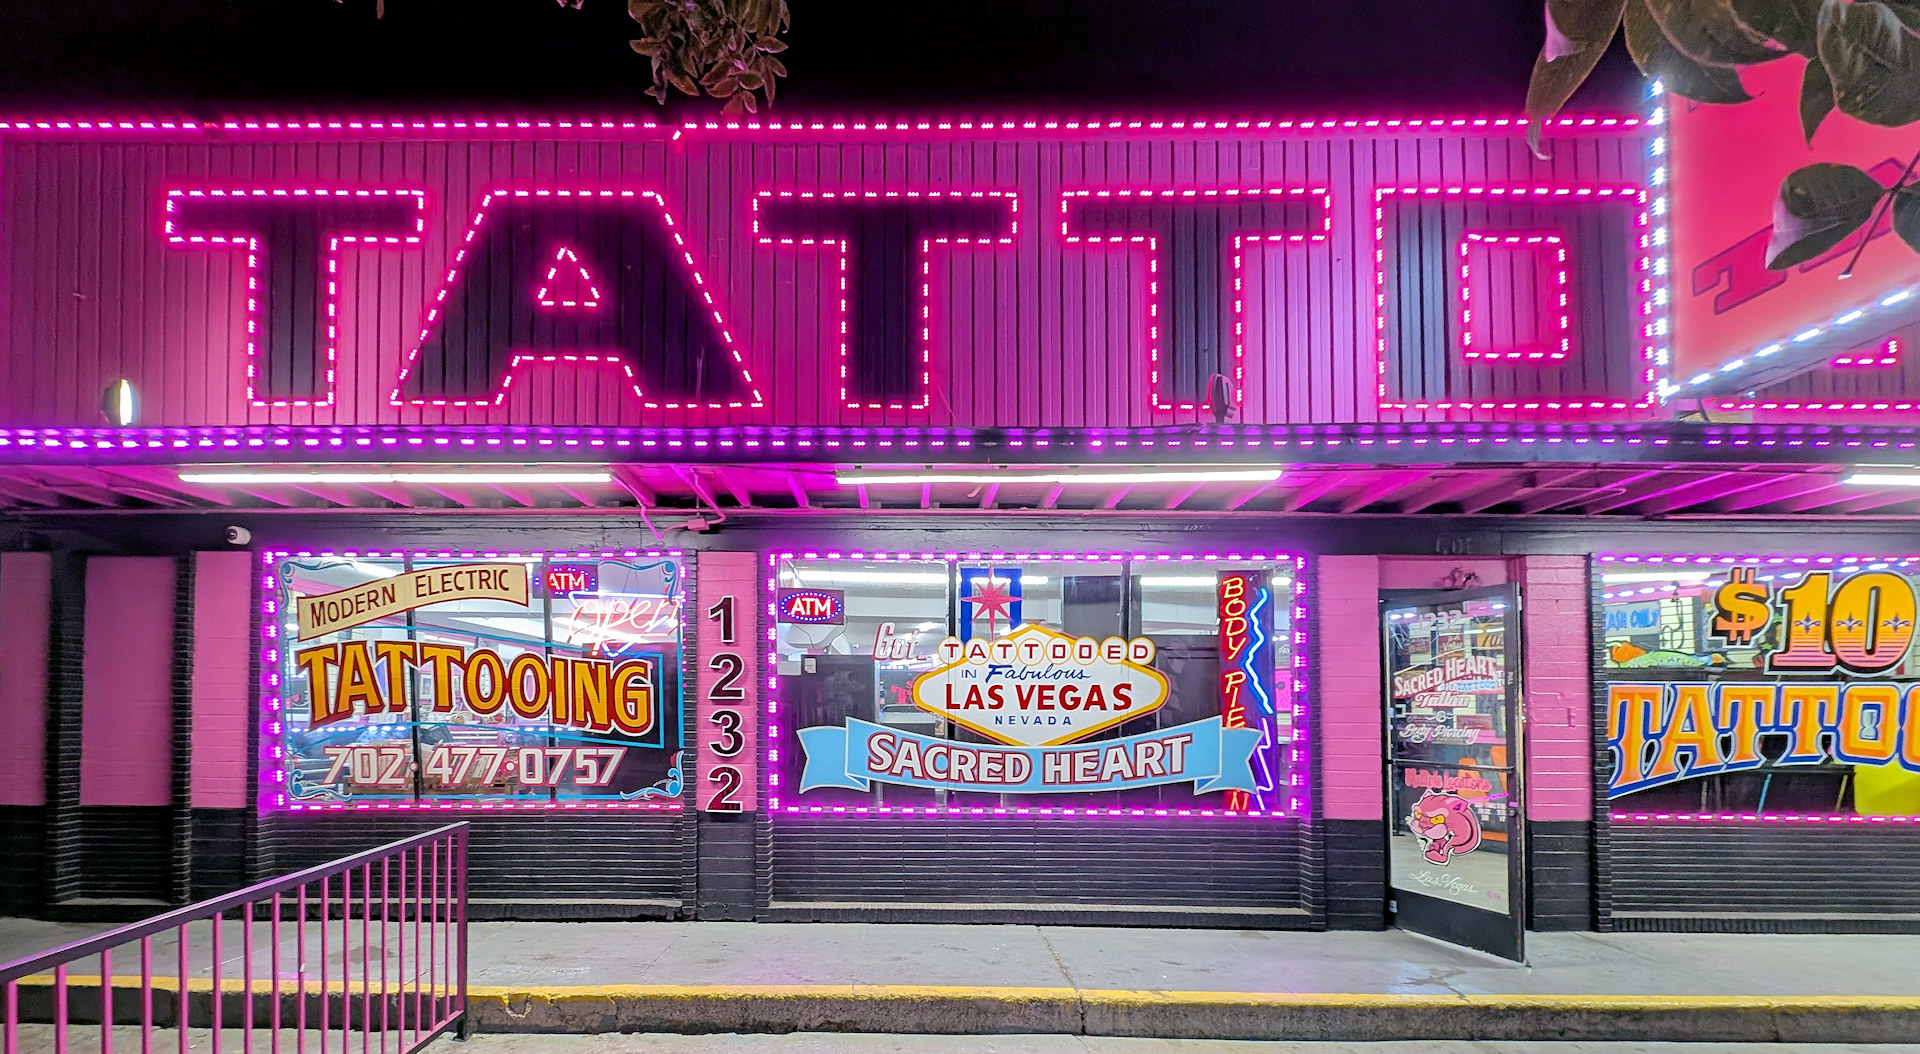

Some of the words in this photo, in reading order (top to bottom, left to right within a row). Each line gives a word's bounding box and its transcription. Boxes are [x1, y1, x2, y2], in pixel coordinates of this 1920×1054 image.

[165, 187, 1896, 411] TATTO
[549, 573, 585, 591] ATM
[310, 583, 396, 629] MODERN
[415, 569, 510, 598] ELECTRIC
[791, 598, 831, 617] ATM
[1223, 577, 1247, 660] BODY
[1708, 566, 1917, 677] $10
[942, 640, 1152, 662] TATTOOED
[297, 640, 656, 736] TATTOOING
[961, 669, 977, 679] IN
[985, 664, 1092, 684] Fabulous
[1393, 667, 1444, 698] SACRED
[1444, 655, 1498, 682] HEART
[945, 684, 1004, 710] LAS
[1015, 683, 1133, 711] VEGAS
[994, 715, 1073, 726] NEVADA
[1399, 723, 1431, 743] Body
[1431, 725, 1480, 744] Piercing
[867, 731, 1032, 785] SACRED
[1043, 734, 1193, 784] HEART
[1408, 870, 1442, 887] Las
[1441, 874, 1478, 895] Vegas
